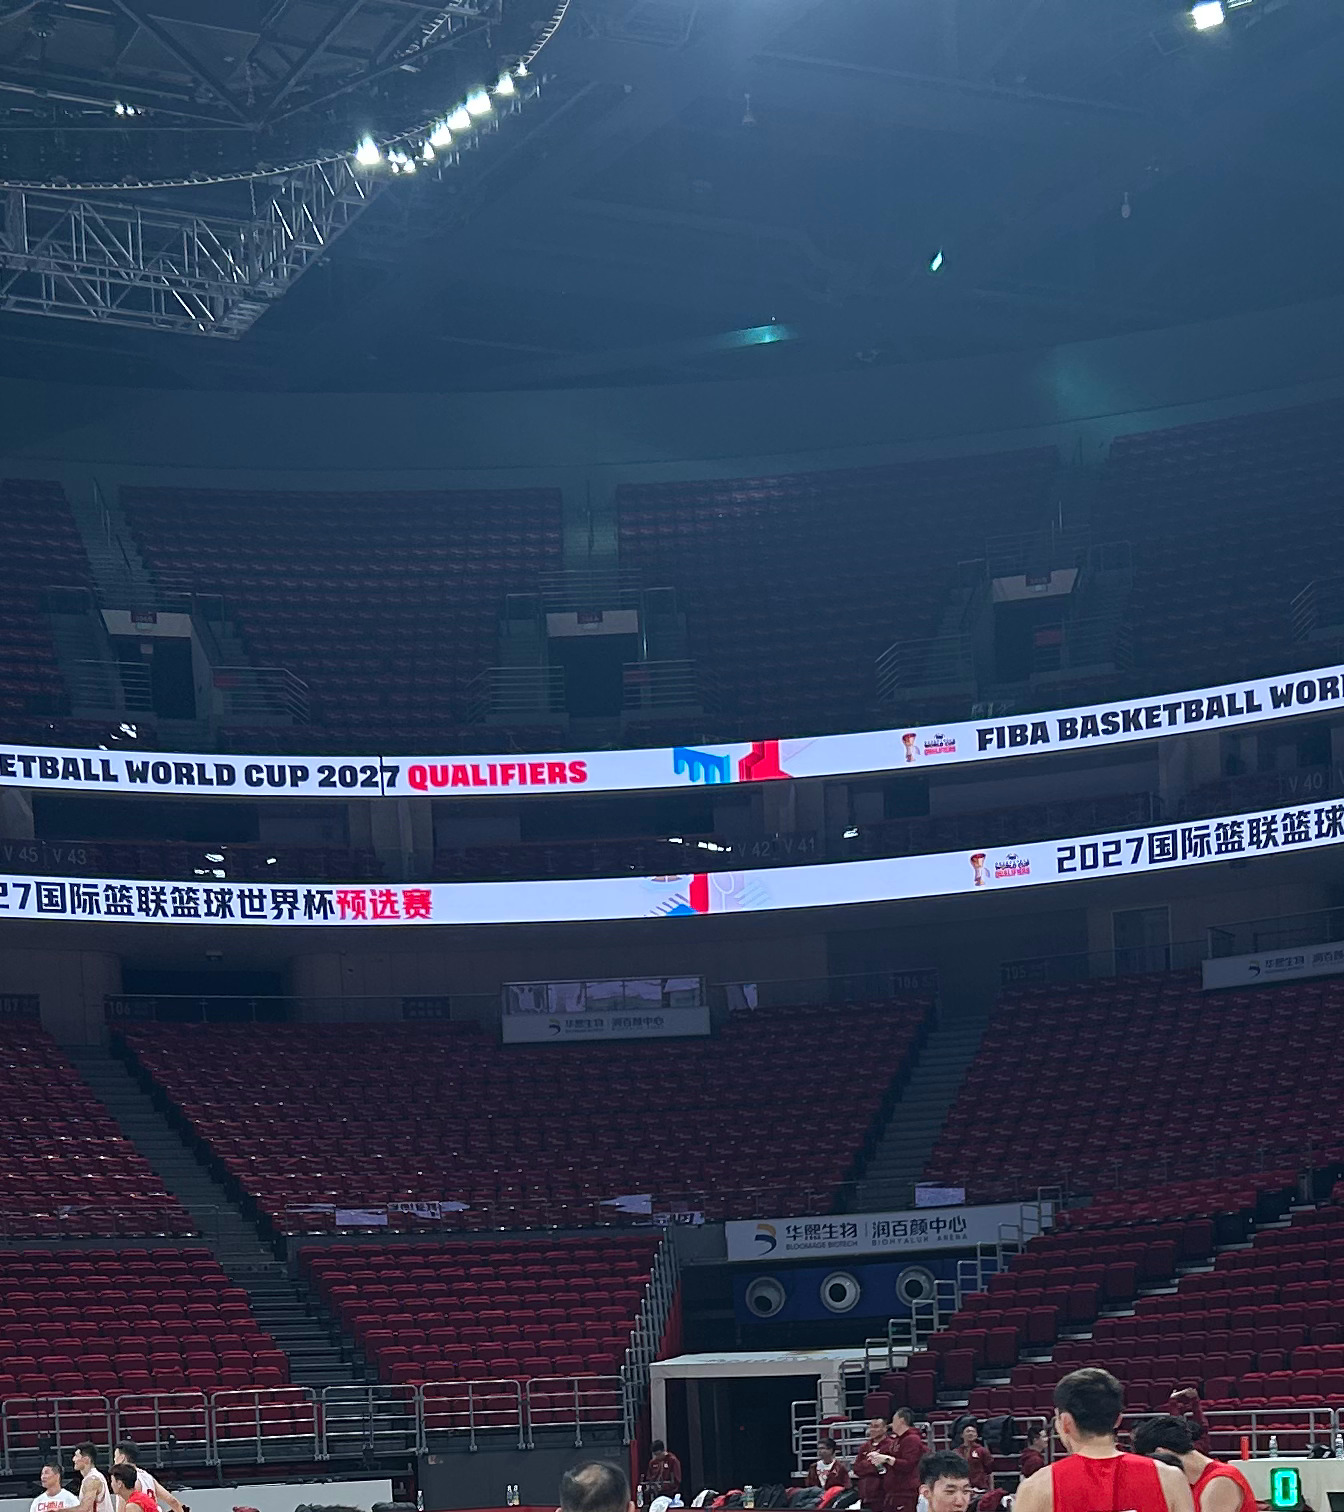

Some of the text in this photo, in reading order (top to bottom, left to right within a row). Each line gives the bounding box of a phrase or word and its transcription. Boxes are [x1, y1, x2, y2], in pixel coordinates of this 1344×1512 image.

[975, 722, 1050, 752] FIBA
[1056, 690, 1262, 741] BASKETBALL
[124, 760, 235, 787] WORLD
[244, 764, 310, 787] CUP
[317, 764, 399, 788] 2027
[407, 760, 588, 791] QUALIFIERS
[1304, 772, 1322, 790] 40
[4, 845, 38, 862] V 45
[752, 841, 770, 857] 42
[797, 837, 815, 853] 41
[53, 848, 86, 864] V 43
[786, 1216, 967, 1242] 华熙生物 润百颜中心
[1274, 1469, 1298, 1508] 0
